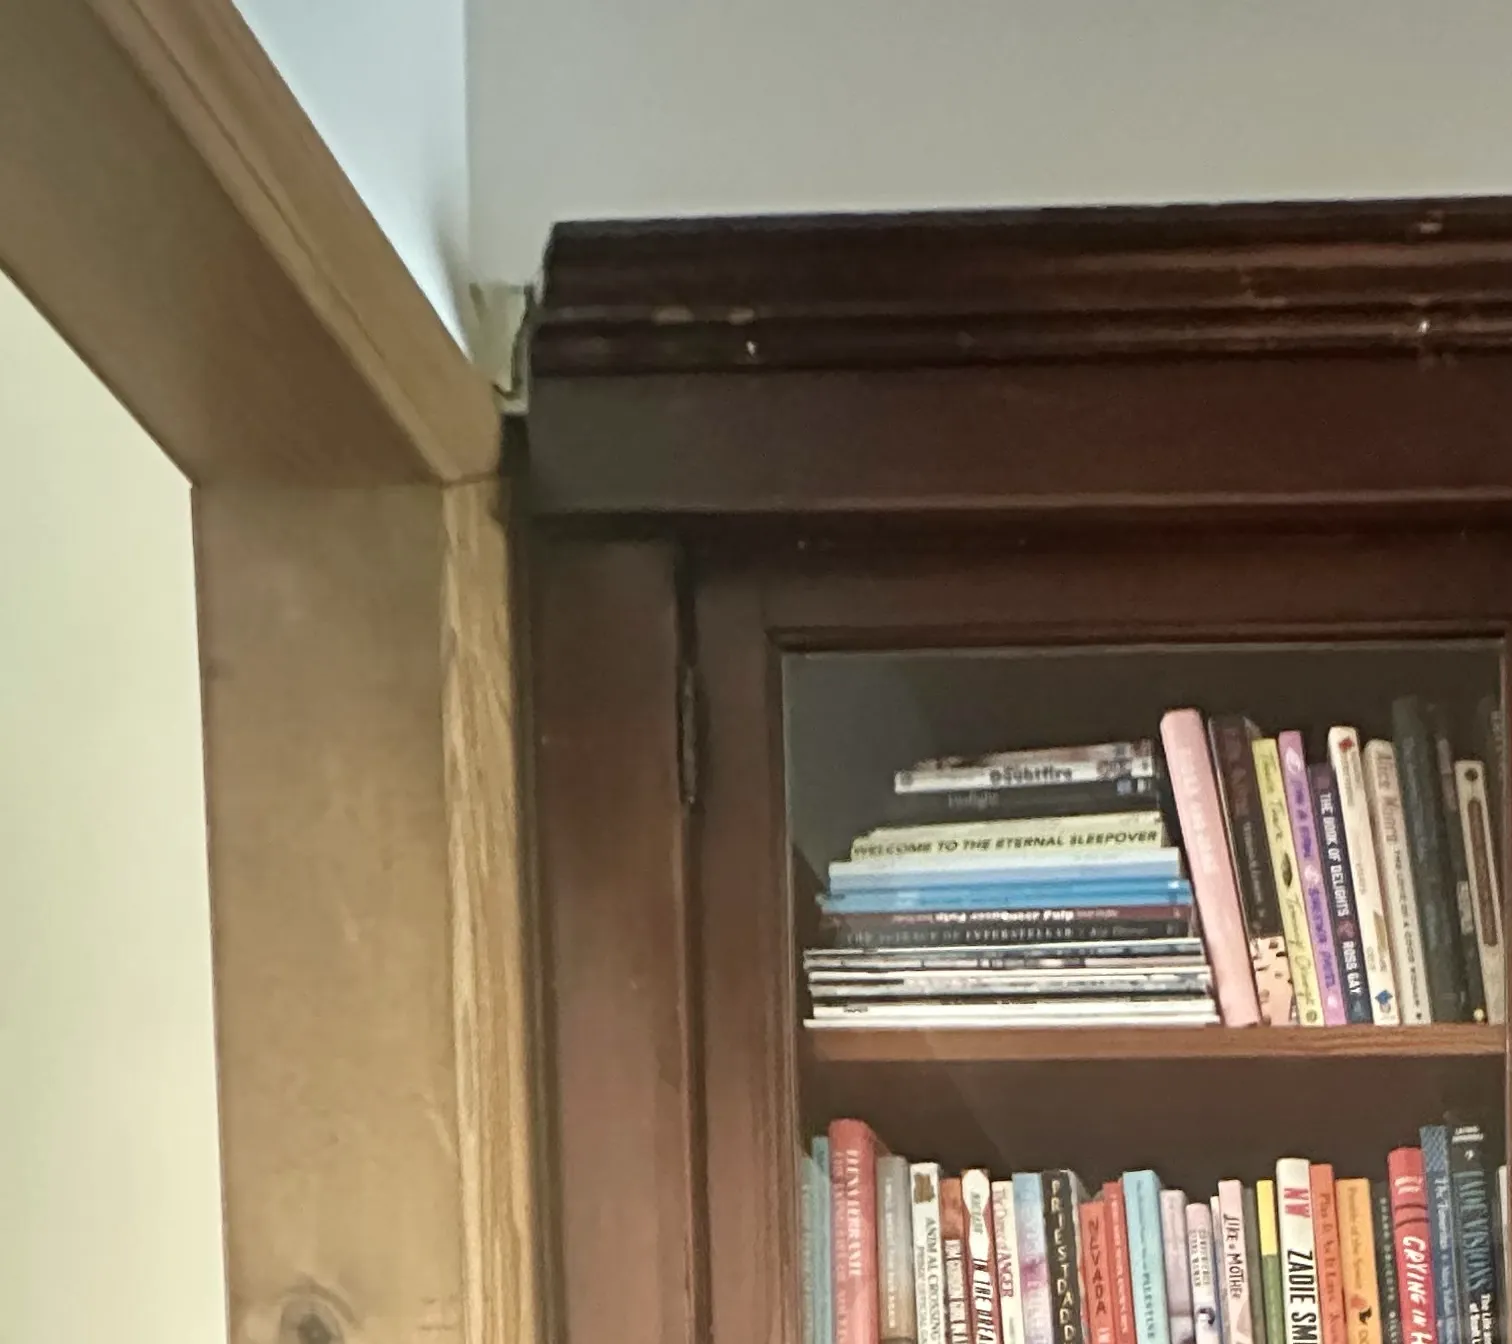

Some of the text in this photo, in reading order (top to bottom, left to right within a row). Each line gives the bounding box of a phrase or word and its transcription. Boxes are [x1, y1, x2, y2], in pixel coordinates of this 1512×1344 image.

[854, 830, 1157, 857] WELCOME TO THE ETERNAL SLEEPOVER
[1320, 793, 1350, 917] THE BOOK OF DELIGHTS
[1342, 941, 1362, 997] ROSS GAY
[1283, 1187, 1311, 1219] NW
[925, 1217, 939, 1270] ANIMAL
[1222, 1214, 1238, 1242] LIKE
[972, 1258, 988, 1272] IN
[998, 1252, 1014, 1298] ANGER
[1088, 1219, 1108, 1317] NEVADA
[1226, 1253, 1245, 1299] MOTHER
[1287, 1249, 1317, 1304] ZADIE
[1403, 1235, 1428, 1300] CRYING
[1460, 1217, 1494, 1292] VISIONS
[974, 1279, 991, 1302] THE
[1480, 1293, 1492, 1311] The
[1412, 1309, 1428, 1328] IN
